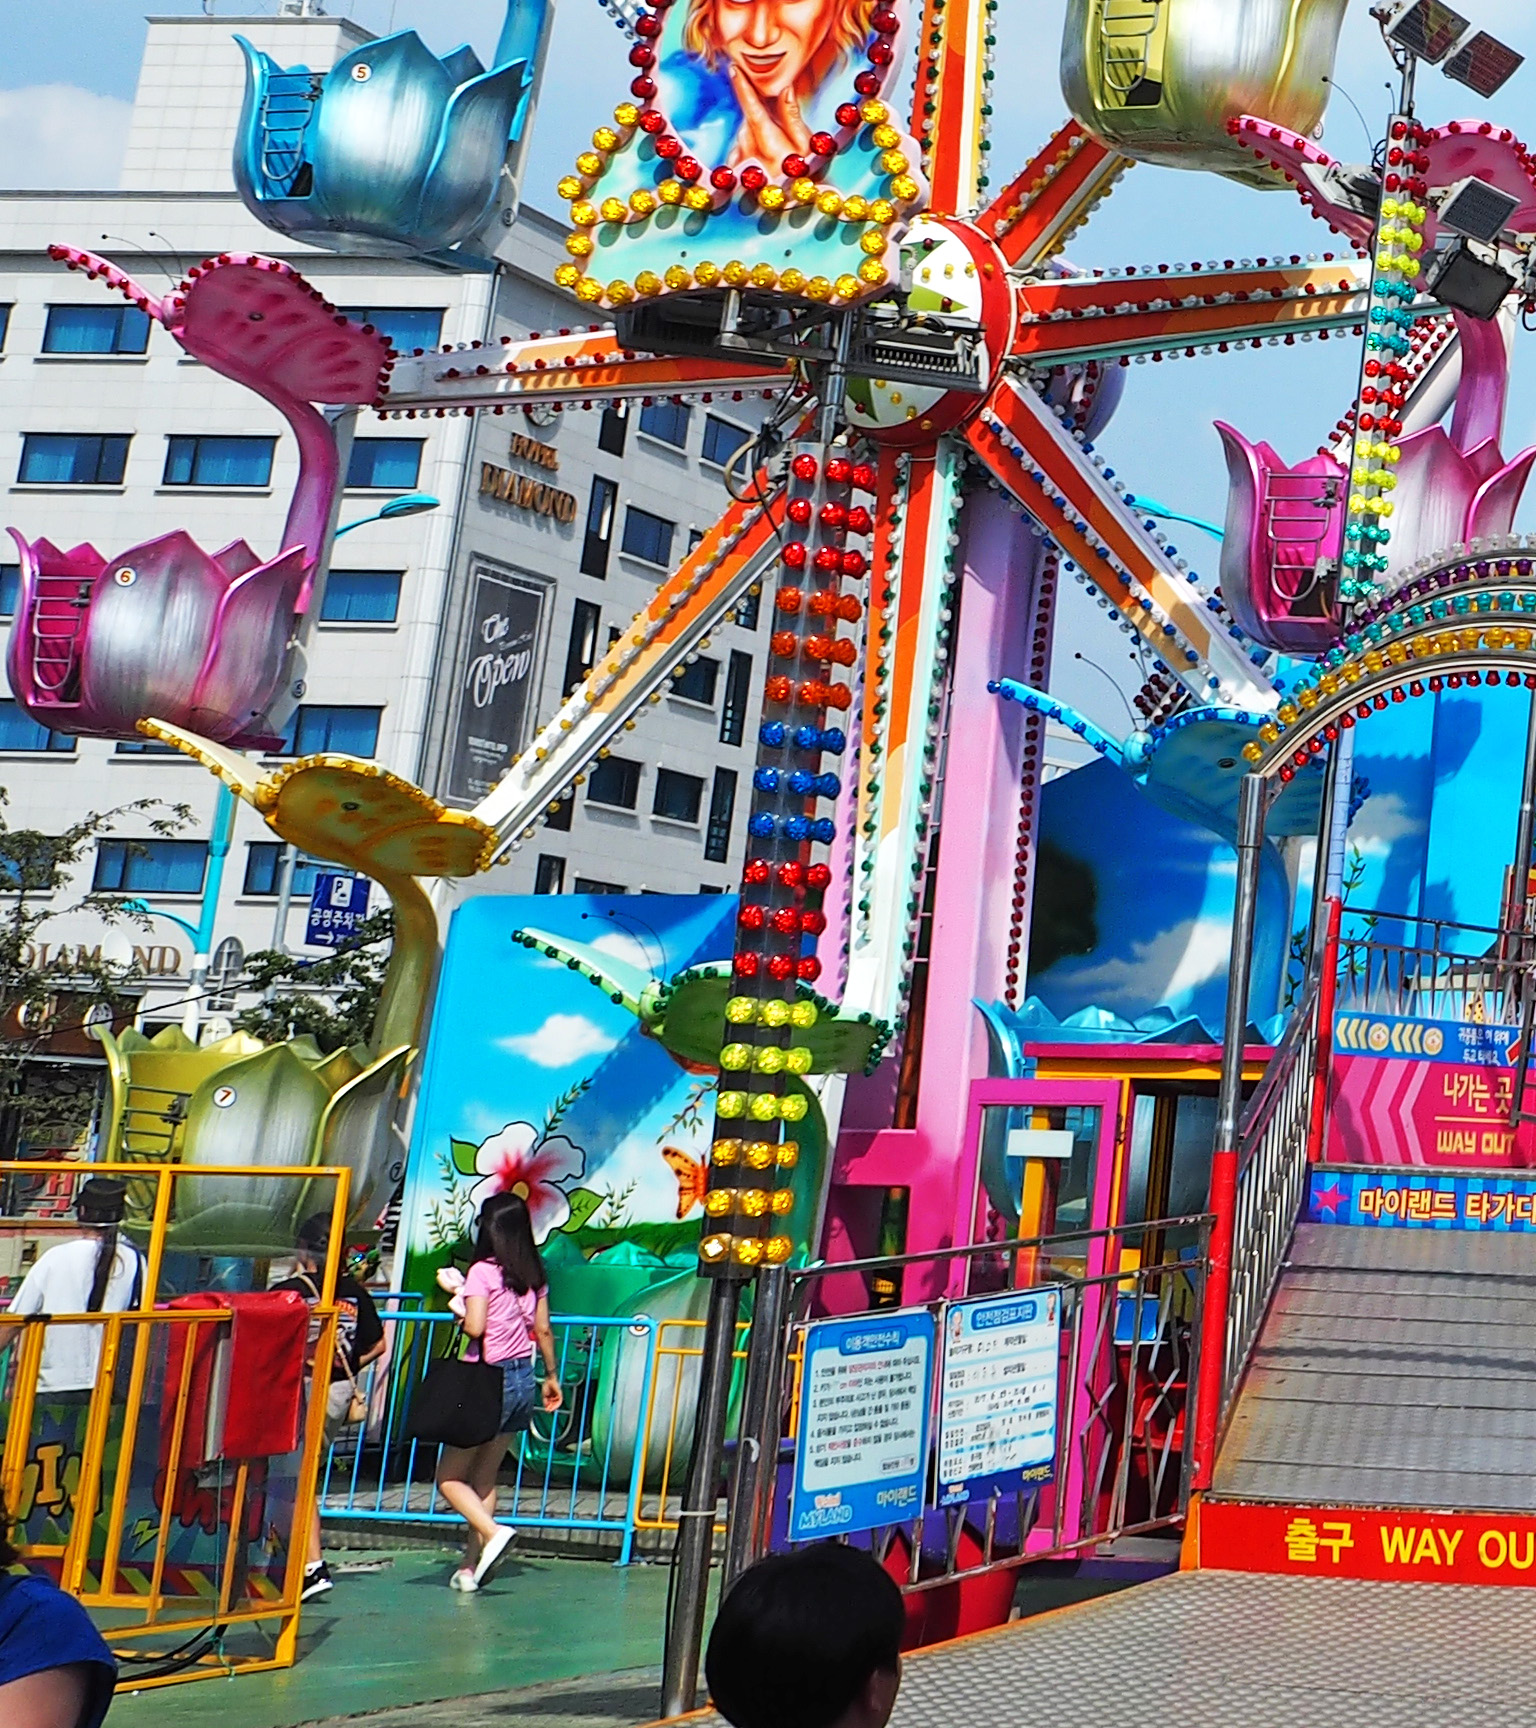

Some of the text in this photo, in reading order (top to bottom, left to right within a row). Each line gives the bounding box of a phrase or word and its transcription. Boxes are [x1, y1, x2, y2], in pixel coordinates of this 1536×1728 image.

[356, 66, 367, 78] 5
[121, 570, 131, 582] 6
[335, 880, 344, 893] P
[220, 1090, 232, 1102] 7
[1444, 1073, 1512, 1114] 나가는 곳
[1437, 1130, 1514, 1155] WAY OUT
[1359, 1187, 1456, 1219] 마이랜드
[876, 1484, 917, 1508] 마이랜드
[798, 1505, 853, 1530] MYLAND
[1285, 1518, 1354, 1563] 출구
[1380, 1526, 1463, 1565] WAY
